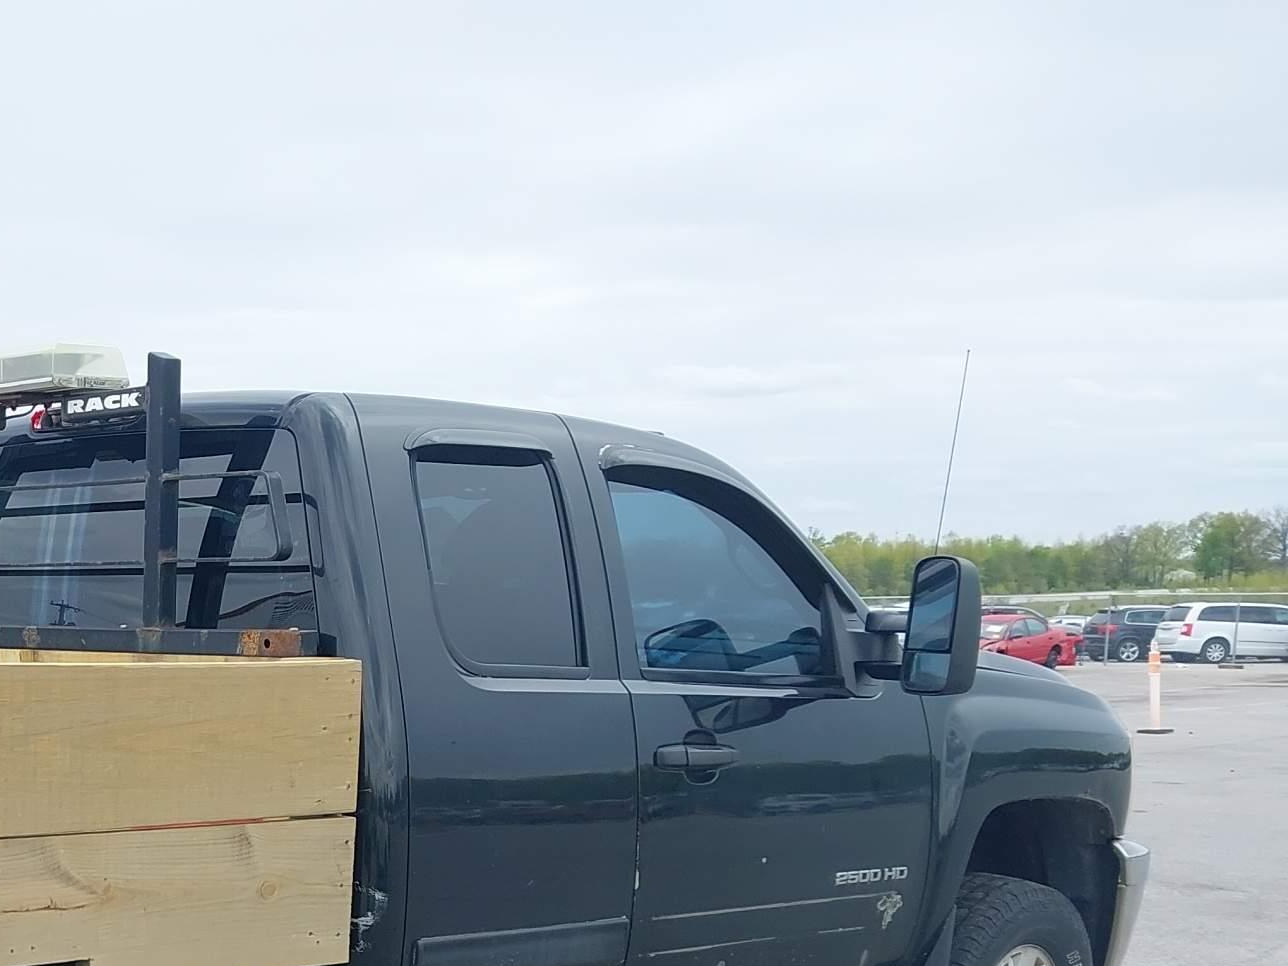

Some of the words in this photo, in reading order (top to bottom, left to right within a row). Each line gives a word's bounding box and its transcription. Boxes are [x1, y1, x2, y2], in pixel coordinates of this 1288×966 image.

[67, 391, 140, 414] RACK
[835, 869, 881, 886] 2500
[884, 866, 908, 881] HD
